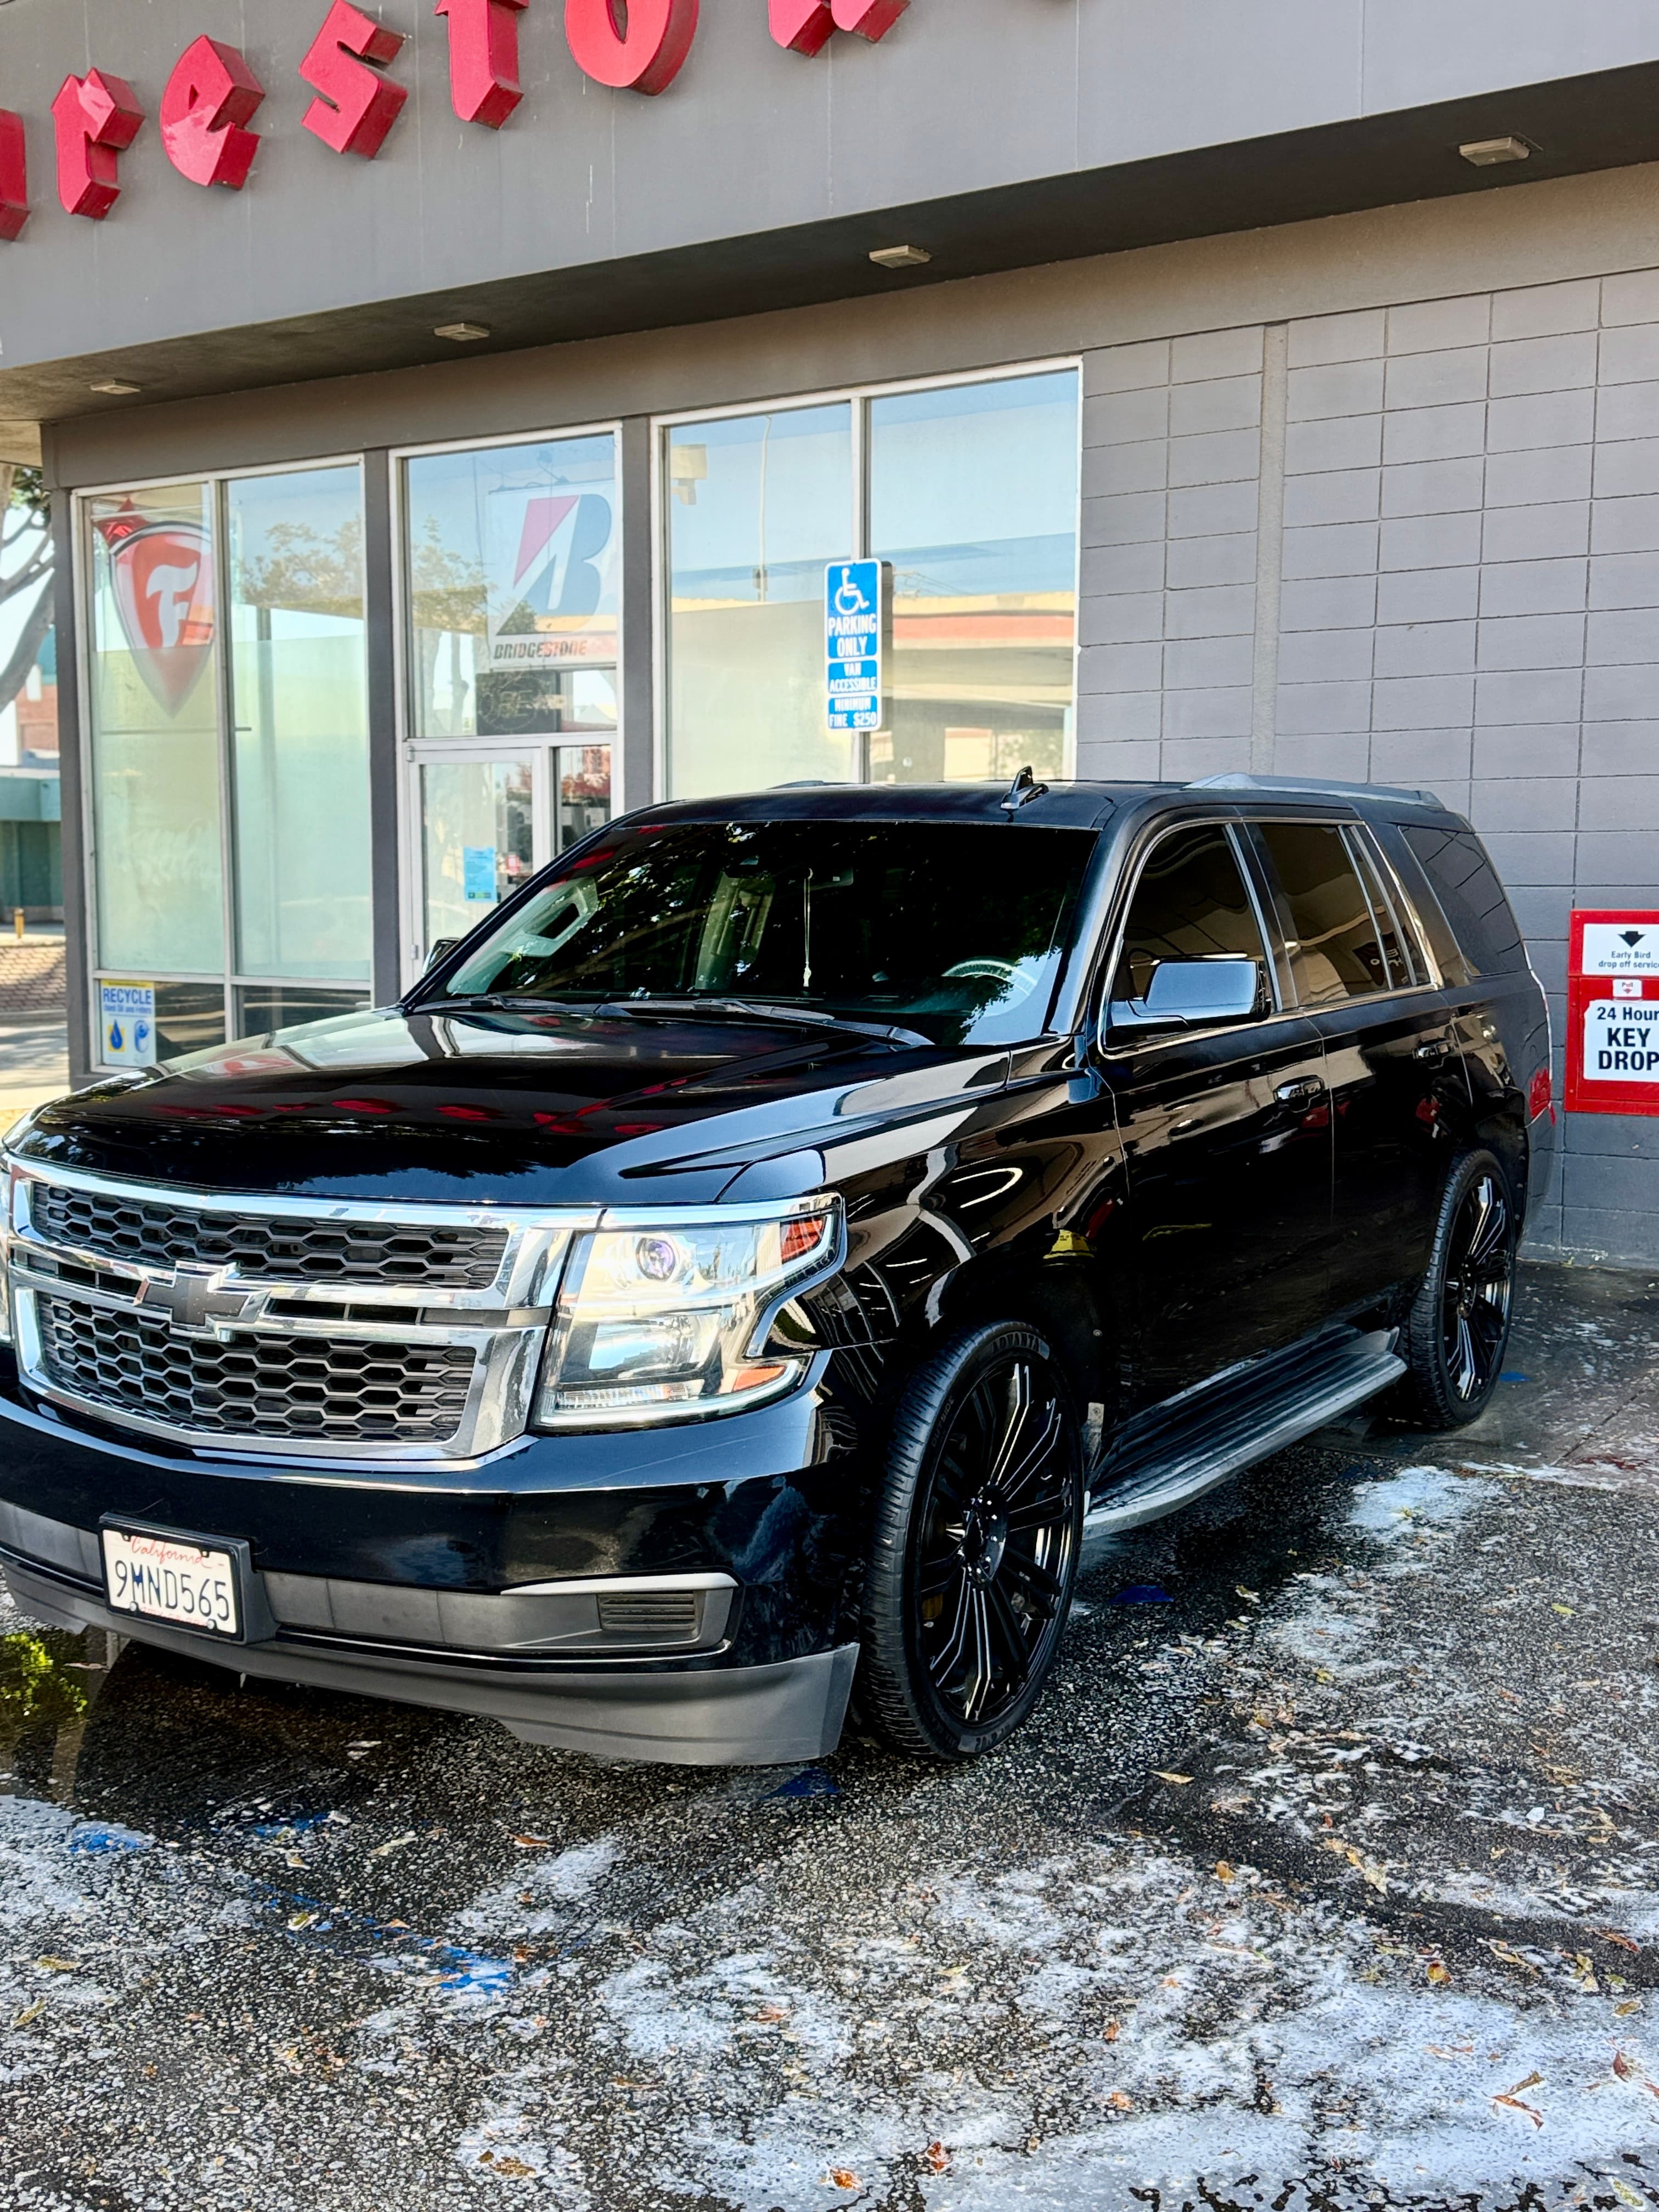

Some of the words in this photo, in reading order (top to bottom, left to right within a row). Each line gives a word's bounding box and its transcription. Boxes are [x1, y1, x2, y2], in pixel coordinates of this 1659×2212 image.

[828, 613, 877, 636] PARKING
[494, 640, 588, 659] BRIDGESTONE
[837, 636, 868, 657] ONLY
[844, 662, 862, 676] VAN
[829, 676, 877, 693] ACCESSIBLE
[834, 696, 872, 712] MINIMUM
[829, 713, 848, 727] FINE
[853, 711, 877, 726] $250
[1611, 951, 1632, 960] Early
[1634, 951, 1651, 959] Bird
[1598, 960, 1617, 969] drop
[103, 988, 152, 1005] RECYCLE
[1596, 1007, 1617, 1020] 24
[1622, 1007, 1659, 1021] Hour
[1607, 1027, 1651, 1047] KEY
[1598, 1050, 1659, 1071] DROP
[131, 1536, 212, 1569] California
[115, 1560, 230, 1622] 9MND565
